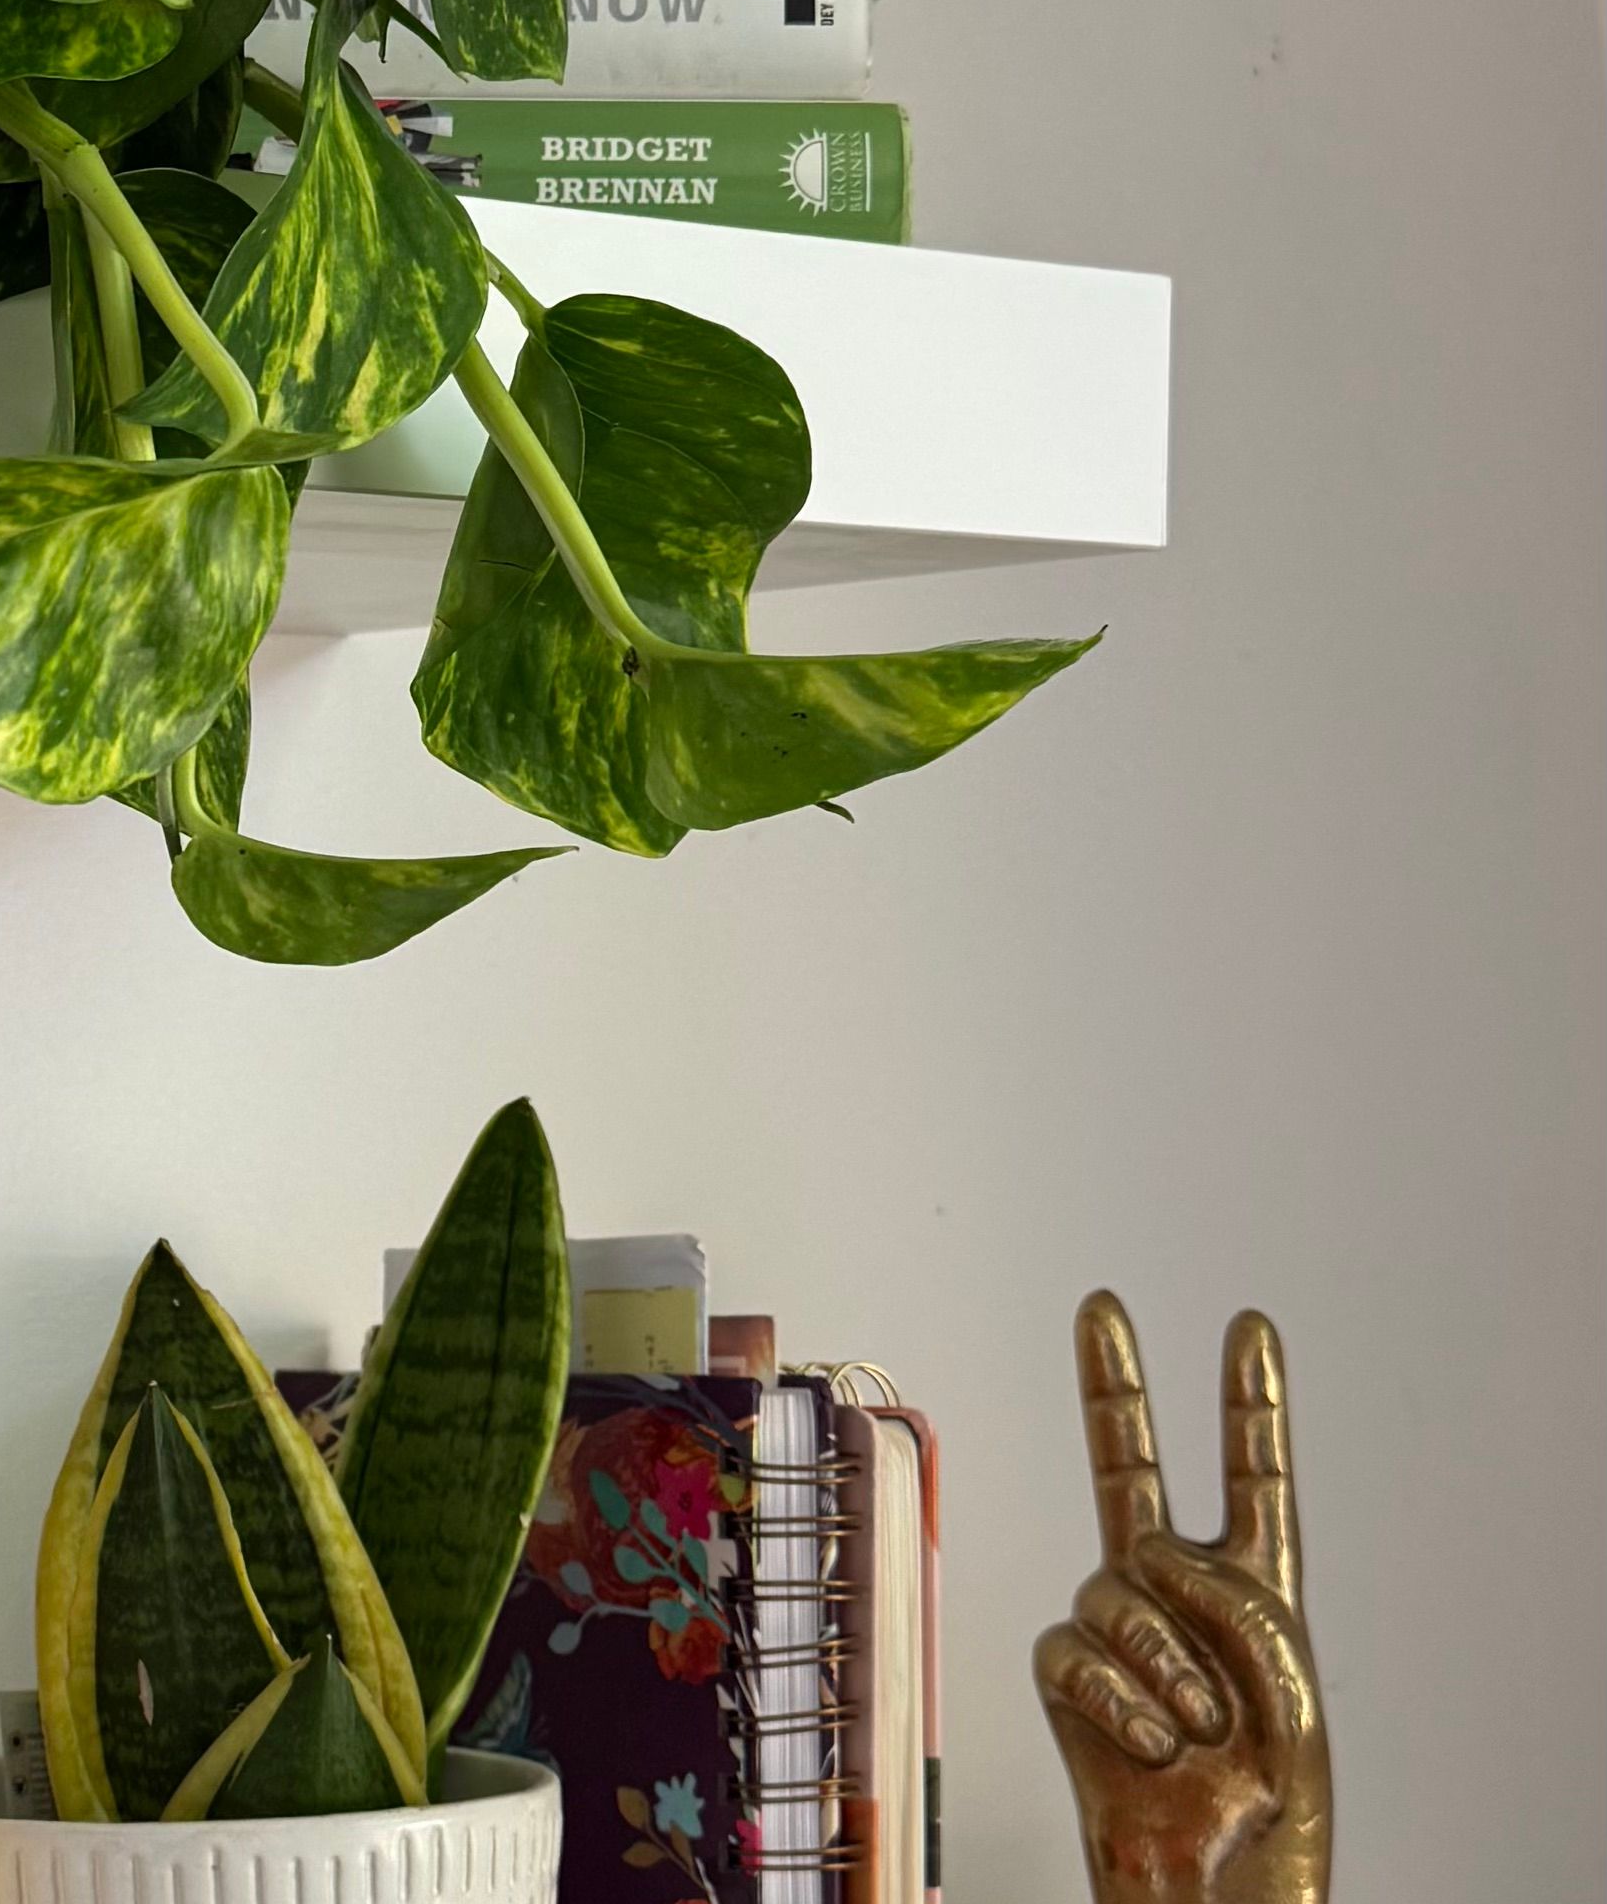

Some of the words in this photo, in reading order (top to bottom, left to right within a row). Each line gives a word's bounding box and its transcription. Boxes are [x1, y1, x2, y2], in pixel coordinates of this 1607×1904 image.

[821, 1, 834, 26] DEY
[540, 136, 712, 162] BRIDGET
[829, 131, 847, 213] CROWN
[849, 130, 863, 213] BUSINESS
[535, 177, 718, 204] BRENNAN
